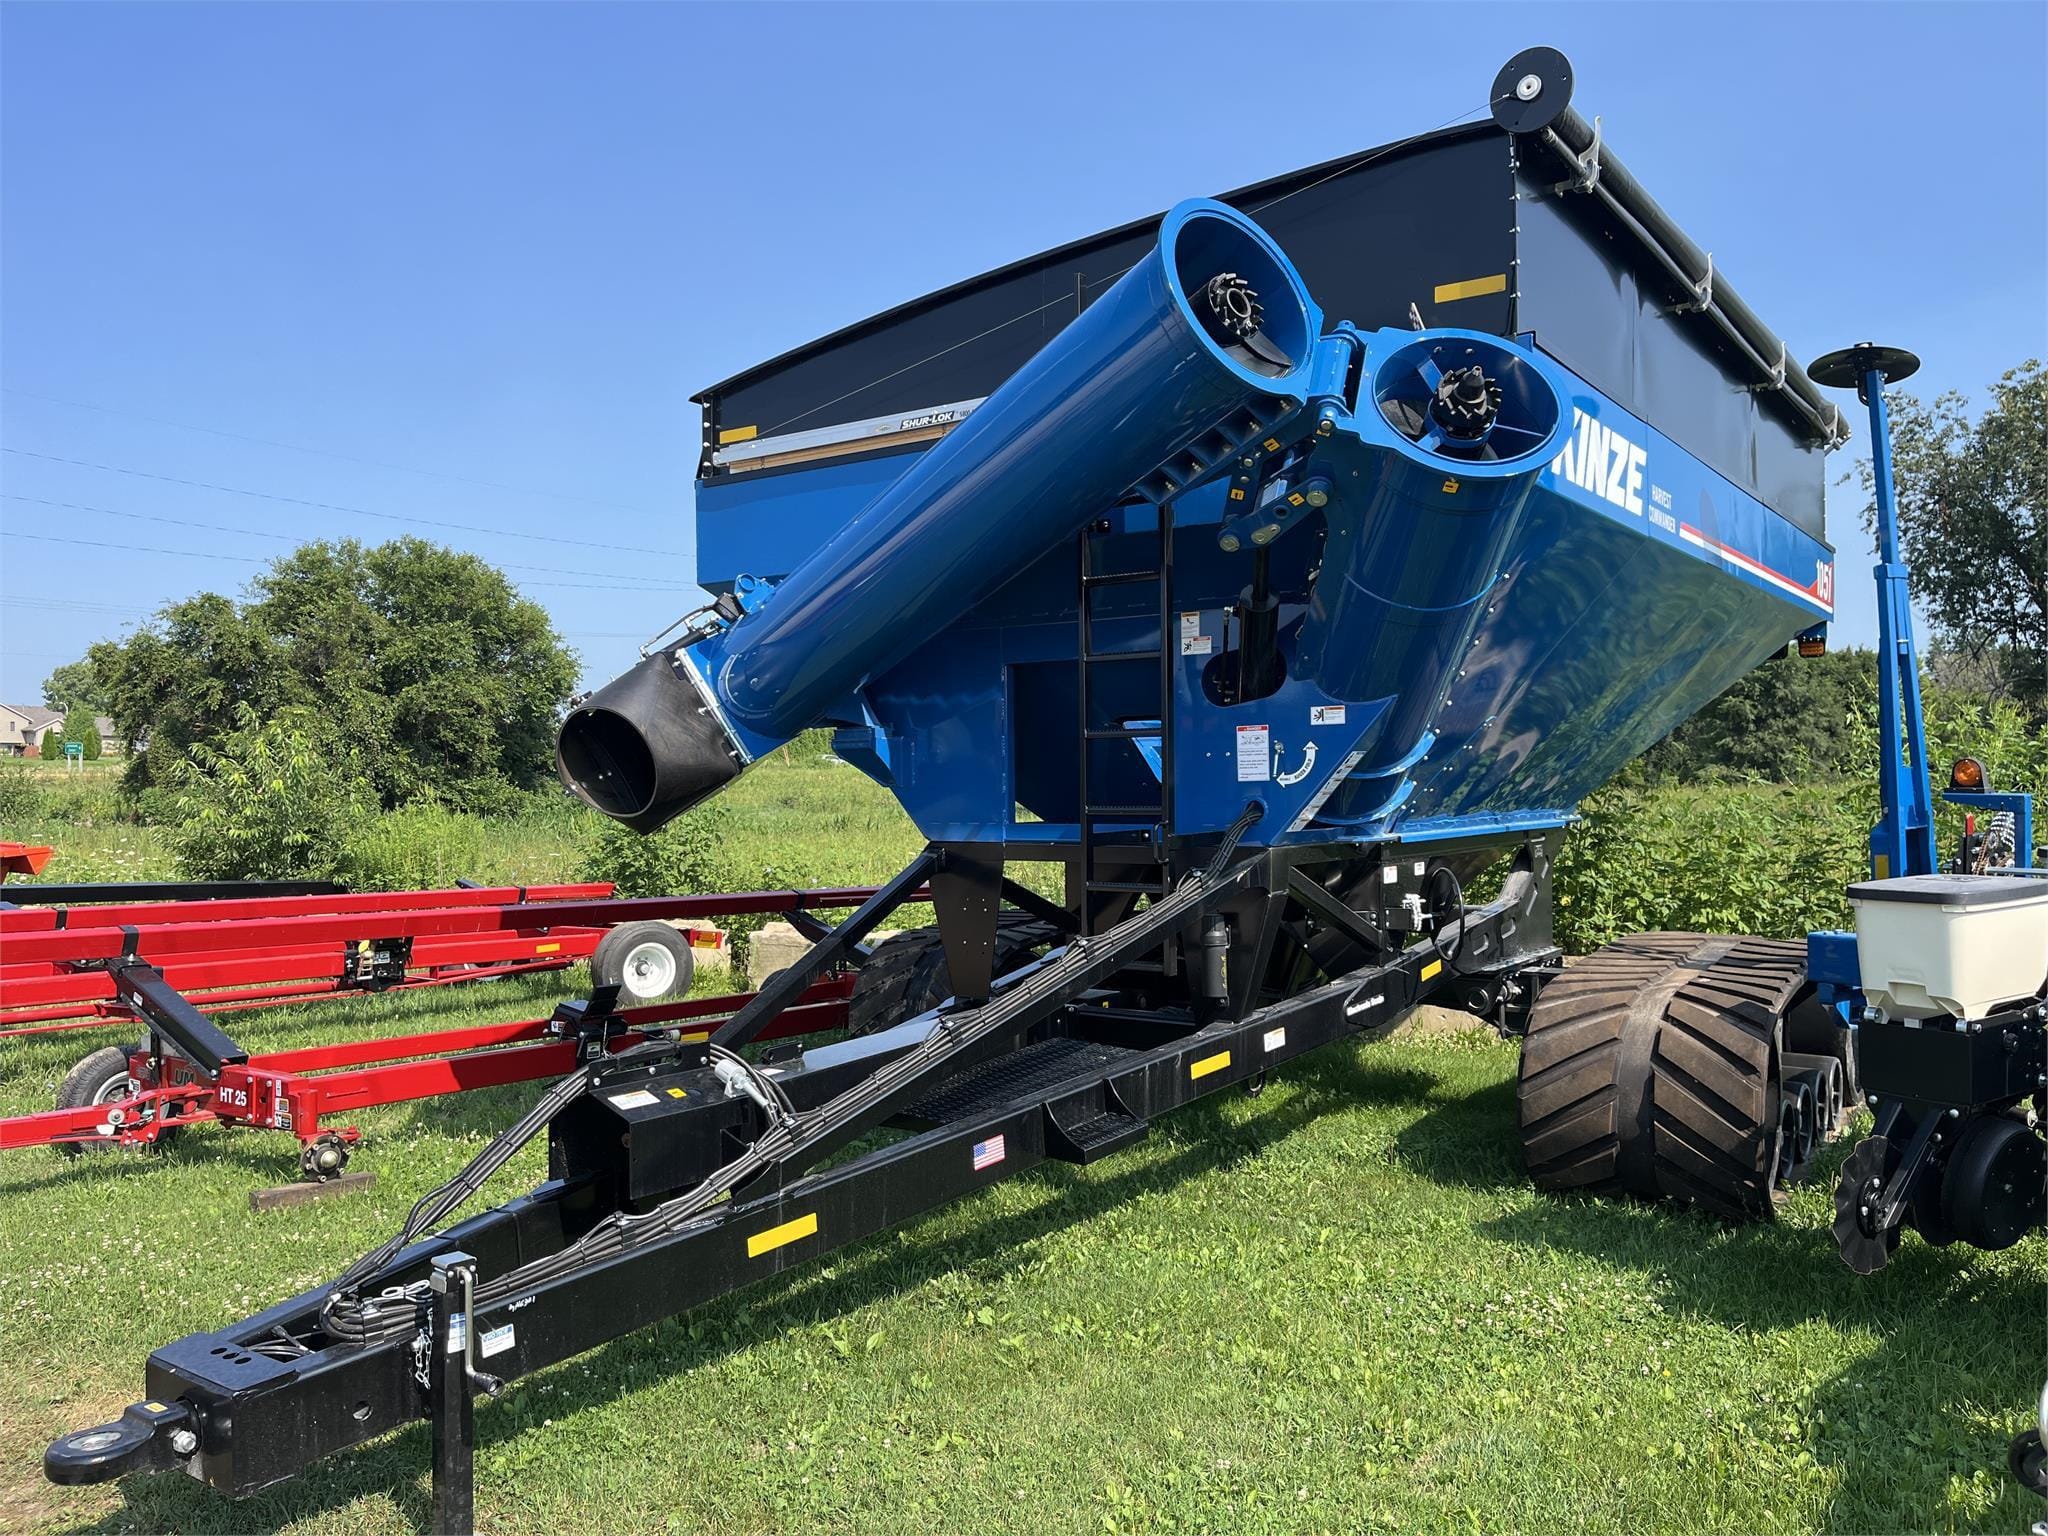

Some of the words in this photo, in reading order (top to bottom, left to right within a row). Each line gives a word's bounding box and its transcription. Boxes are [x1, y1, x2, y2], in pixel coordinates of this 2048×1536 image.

[901, 411, 954, 429] SHUR-LOK
[1651, 484, 1672, 511] HARVEST
[1648, 504, 1677, 534] COMMANDER
[220, 1086, 234, 1104] HT
[235, 1089, 247, 1107] 25
